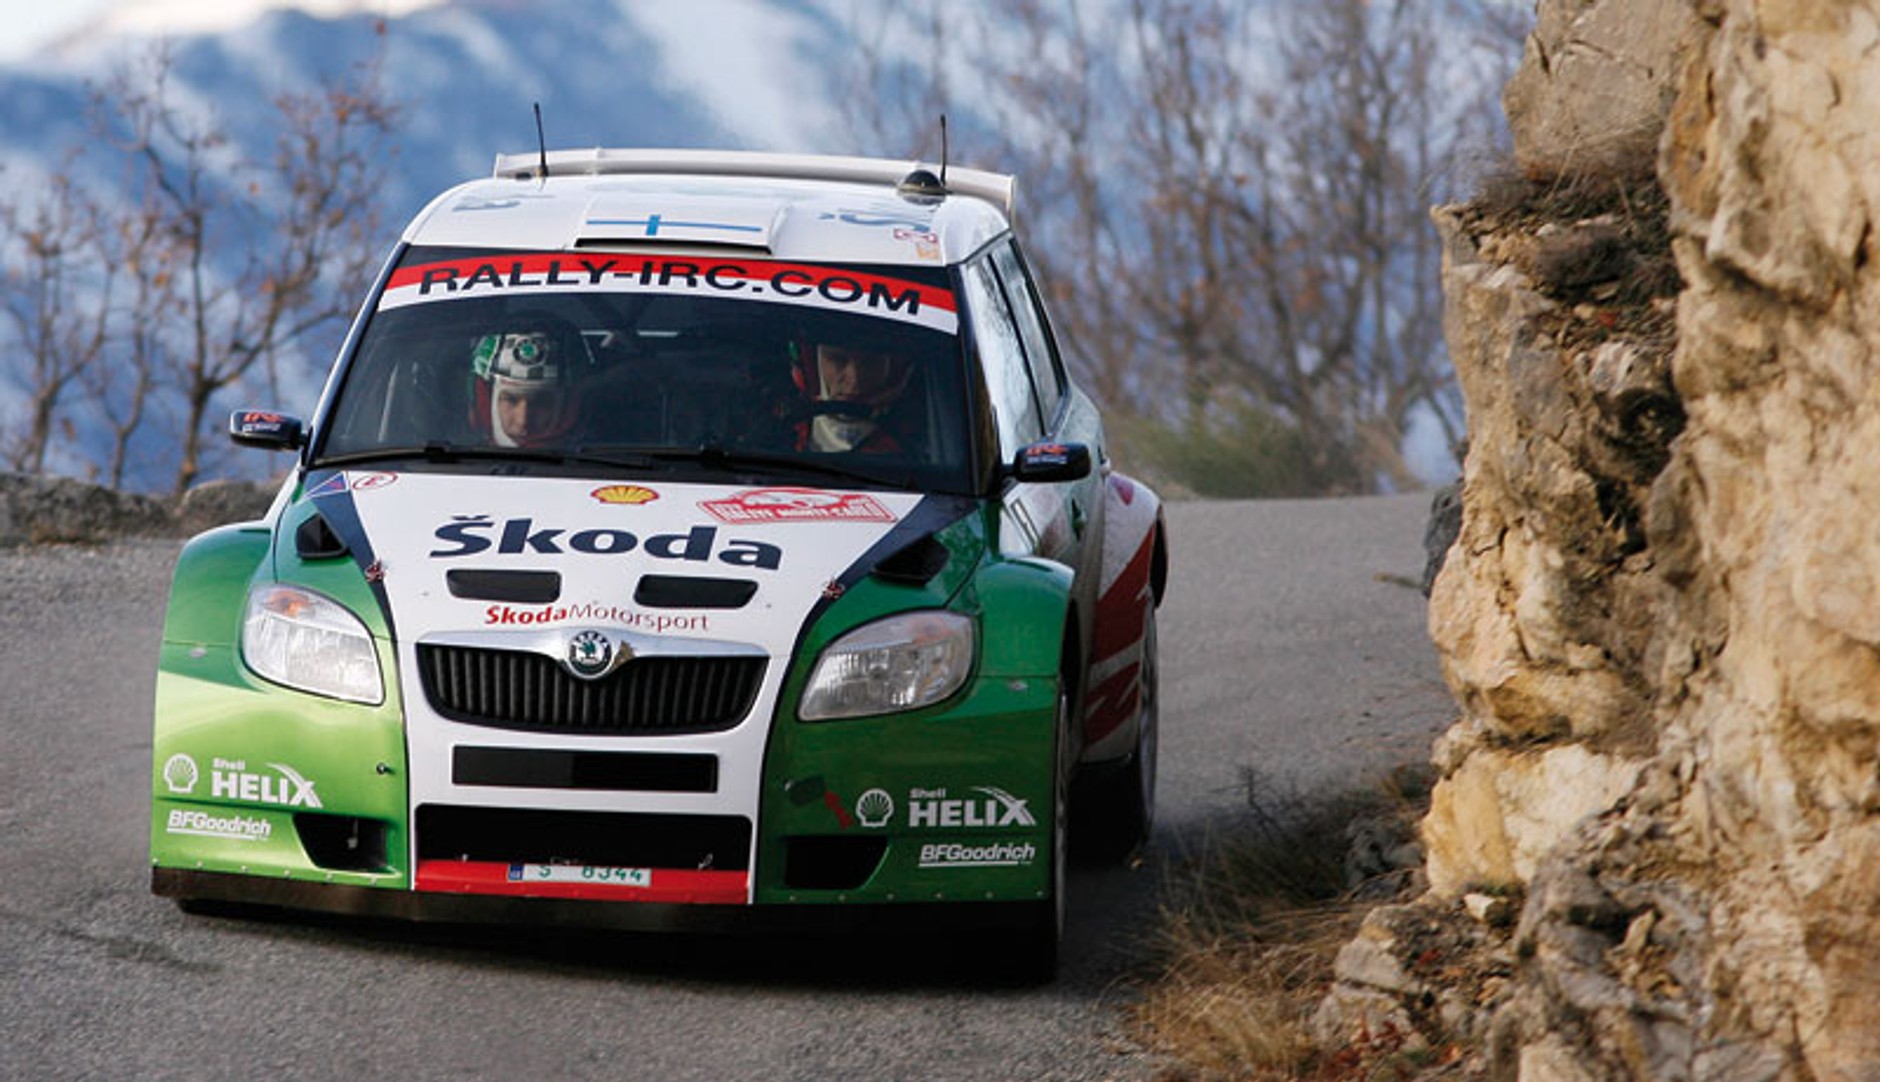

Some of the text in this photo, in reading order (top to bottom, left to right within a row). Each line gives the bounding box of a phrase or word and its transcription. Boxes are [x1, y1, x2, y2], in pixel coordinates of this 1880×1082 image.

[418, 259, 921, 315] RALLY-IRC.COM
[429, 514, 782, 570] Škoda
[212, 757, 246, 771] Shell
[211, 762, 323, 809] HELIX
[909, 787, 947, 799] Shell
[167, 809, 272, 837] BFGoodrich
[908, 786, 1036, 827] HELIX
[919, 842, 1036, 863] BFGoodrich
